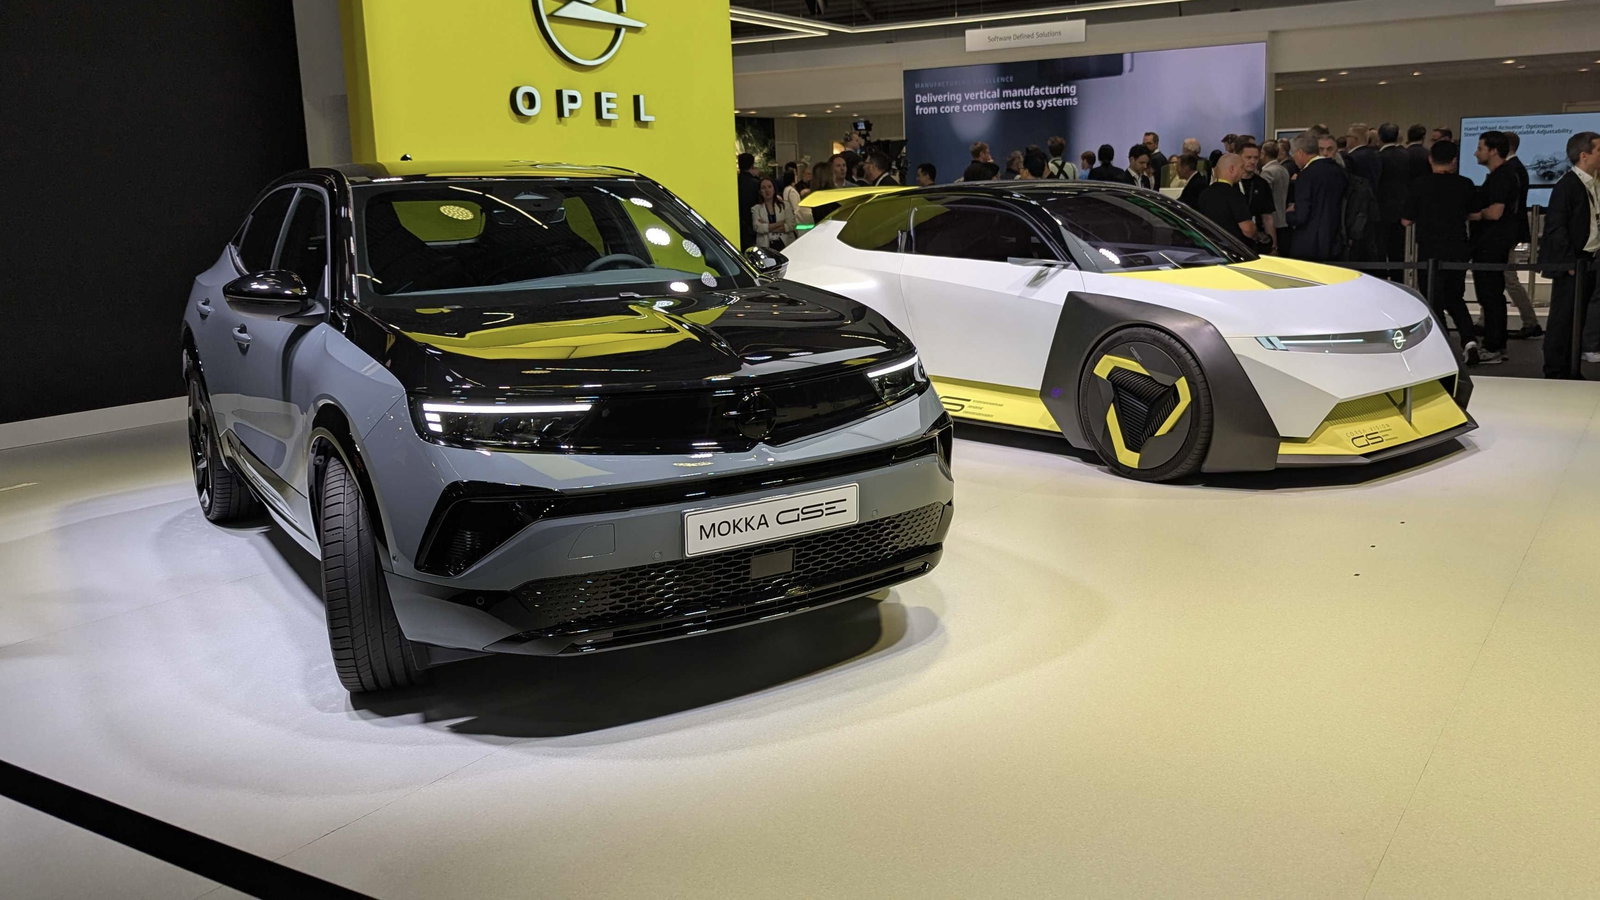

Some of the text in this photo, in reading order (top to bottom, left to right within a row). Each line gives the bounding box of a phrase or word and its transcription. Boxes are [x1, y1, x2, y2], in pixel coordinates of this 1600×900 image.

[1013, 32, 1034, 41] Defined
[1036, 30, 1062, 39] Solutions
[914, 79, 971, 89] MANUFACTURI
[510, 85, 656, 122] OPEL
[915, 84, 1077, 104] Delivering vertical manufacturing
[915, 97, 1078, 115] from core components to systems
[700, 498, 847, 541] MOKKA GSE
